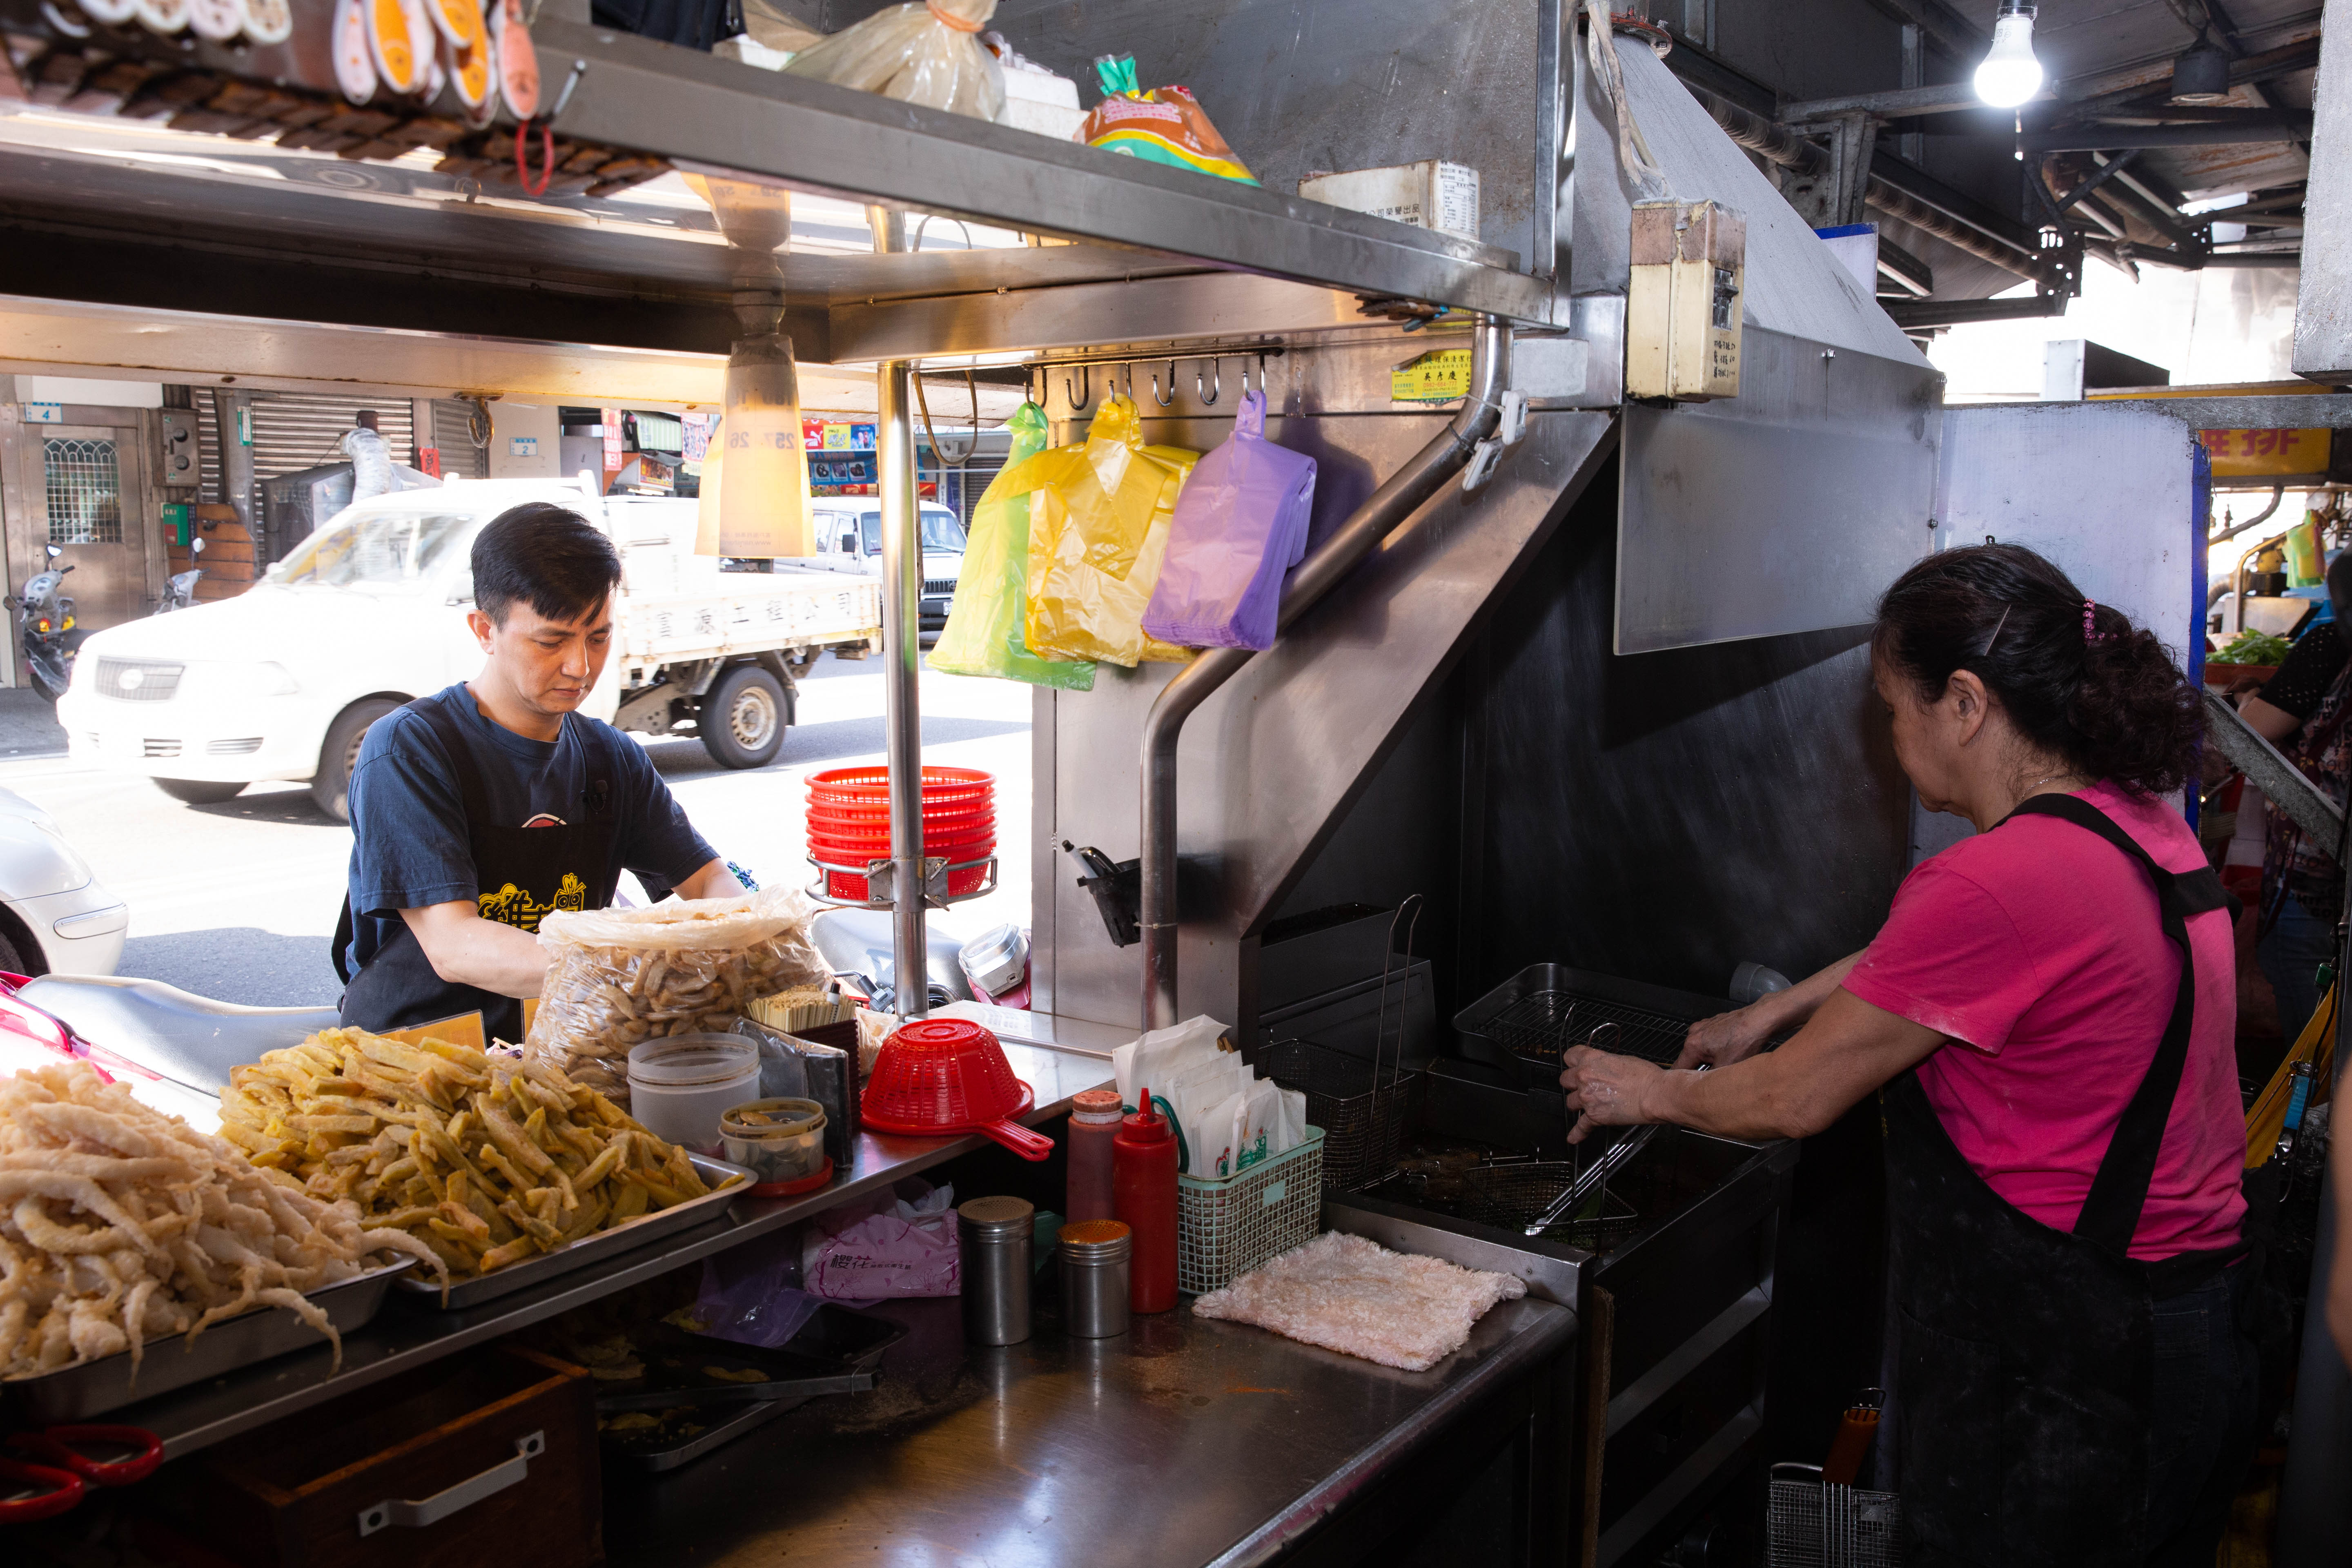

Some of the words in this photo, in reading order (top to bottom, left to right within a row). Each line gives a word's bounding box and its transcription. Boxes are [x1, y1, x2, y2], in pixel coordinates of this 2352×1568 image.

[42, 410, 49, 420] 4
[523, 445, 528, 454] 2
[830, 1254, 872, 1269] 櫻花
